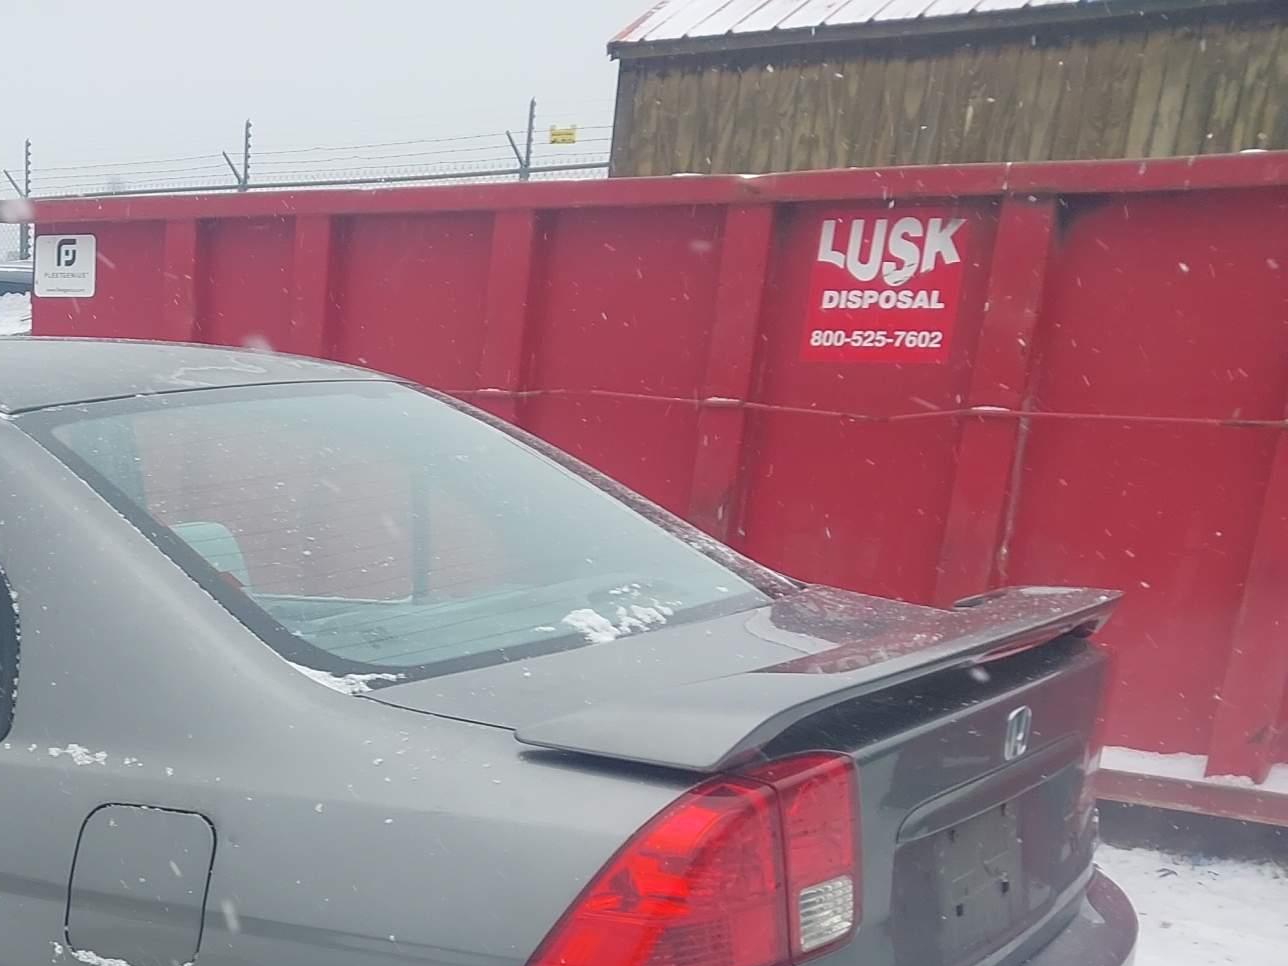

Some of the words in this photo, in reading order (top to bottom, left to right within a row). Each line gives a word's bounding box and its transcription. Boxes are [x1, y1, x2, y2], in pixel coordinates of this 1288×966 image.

[817, 217, 967, 287] LUSK
[822, 290, 945, 309] DISPOSAL
[810, 330, 943, 348] 800-525-7602
